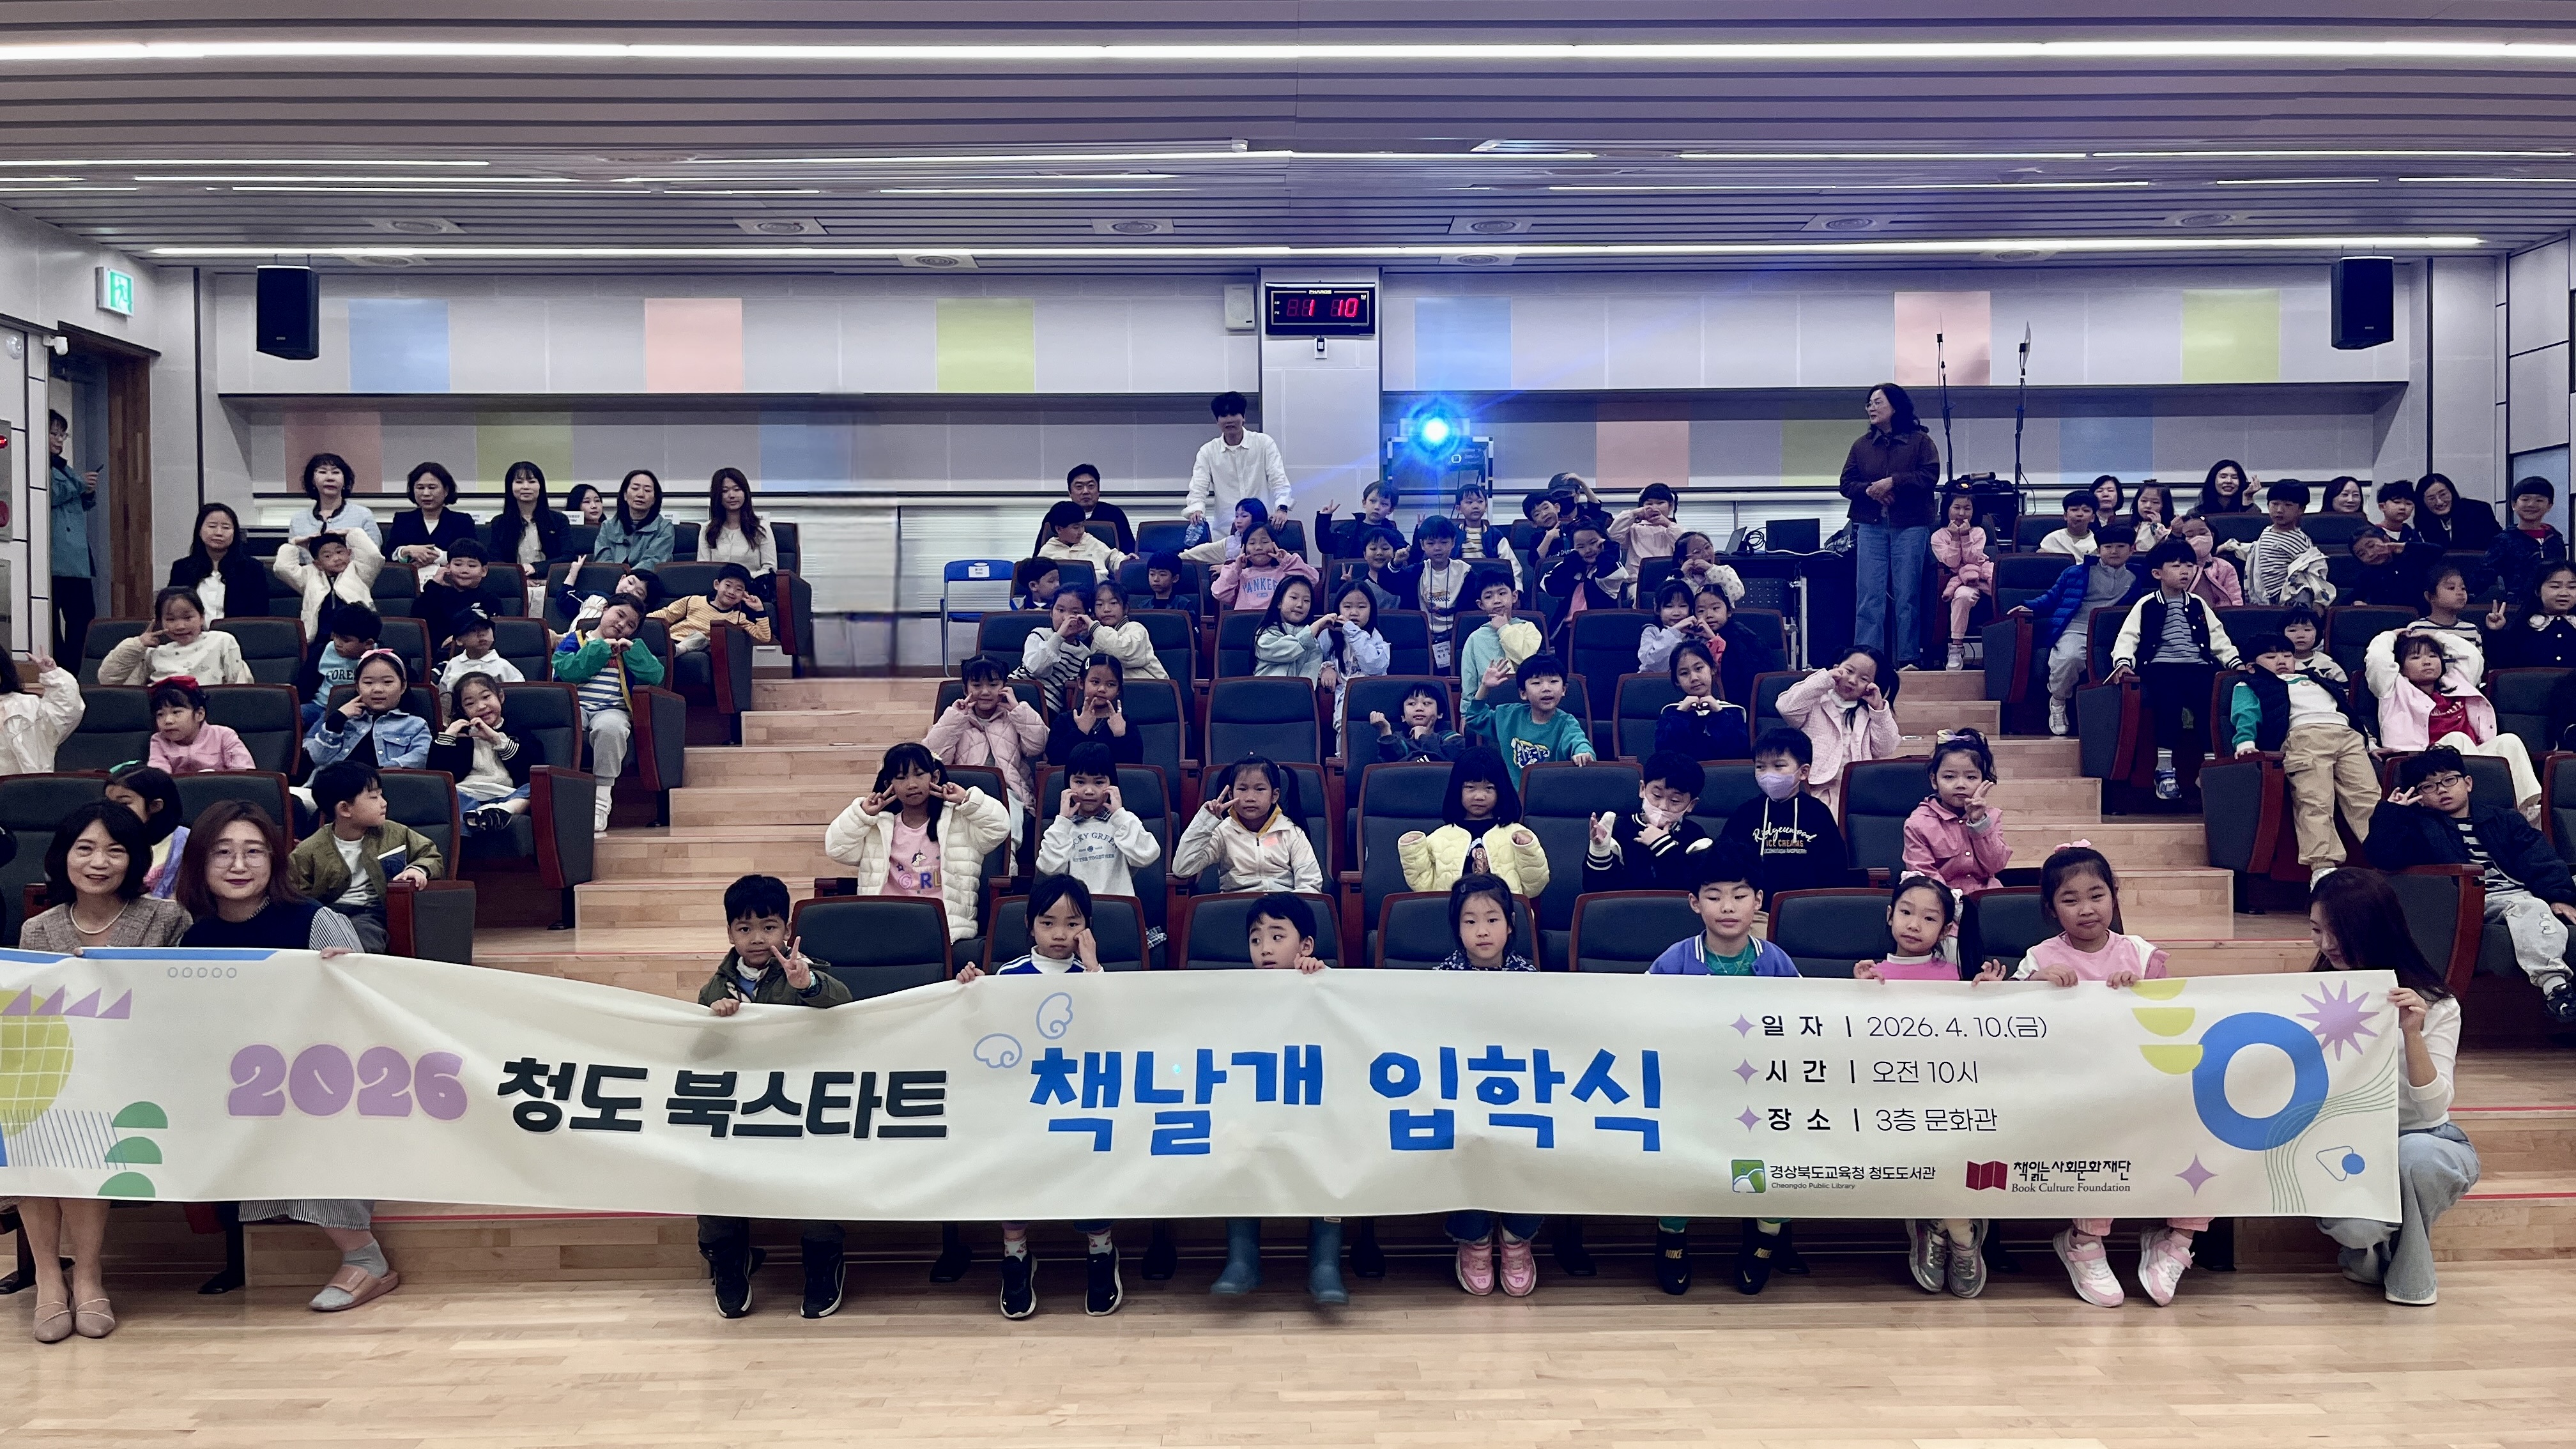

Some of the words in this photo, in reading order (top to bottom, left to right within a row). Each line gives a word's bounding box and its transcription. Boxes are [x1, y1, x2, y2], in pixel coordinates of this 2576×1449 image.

[1873, 1061, 1919, 1084] 오전
[1928, 1061, 1979, 1084] 10시
[228, 1044, 469, 1121] 2026
[497, 1057, 648, 1132] 청도
[666, 1070, 948, 1139] 북스타트
[1029, 1045, 1322, 1155] 책날개
[1369, 1045, 1661, 1151] 입학식
[1875, 1108, 1916, 1131] 3층
[1925, 1108, 1998, 1131] 문화관
[1770, 1165, 1865, 1180] 경상북도교육청
[1869, 1166, 1936, 1180] 청도도서관
[2012, 1183, 2036, 1193] Book
[2039, 1183, 2074, 1193] Culture
[2078, 1183, 2131, 1193] Foundation
